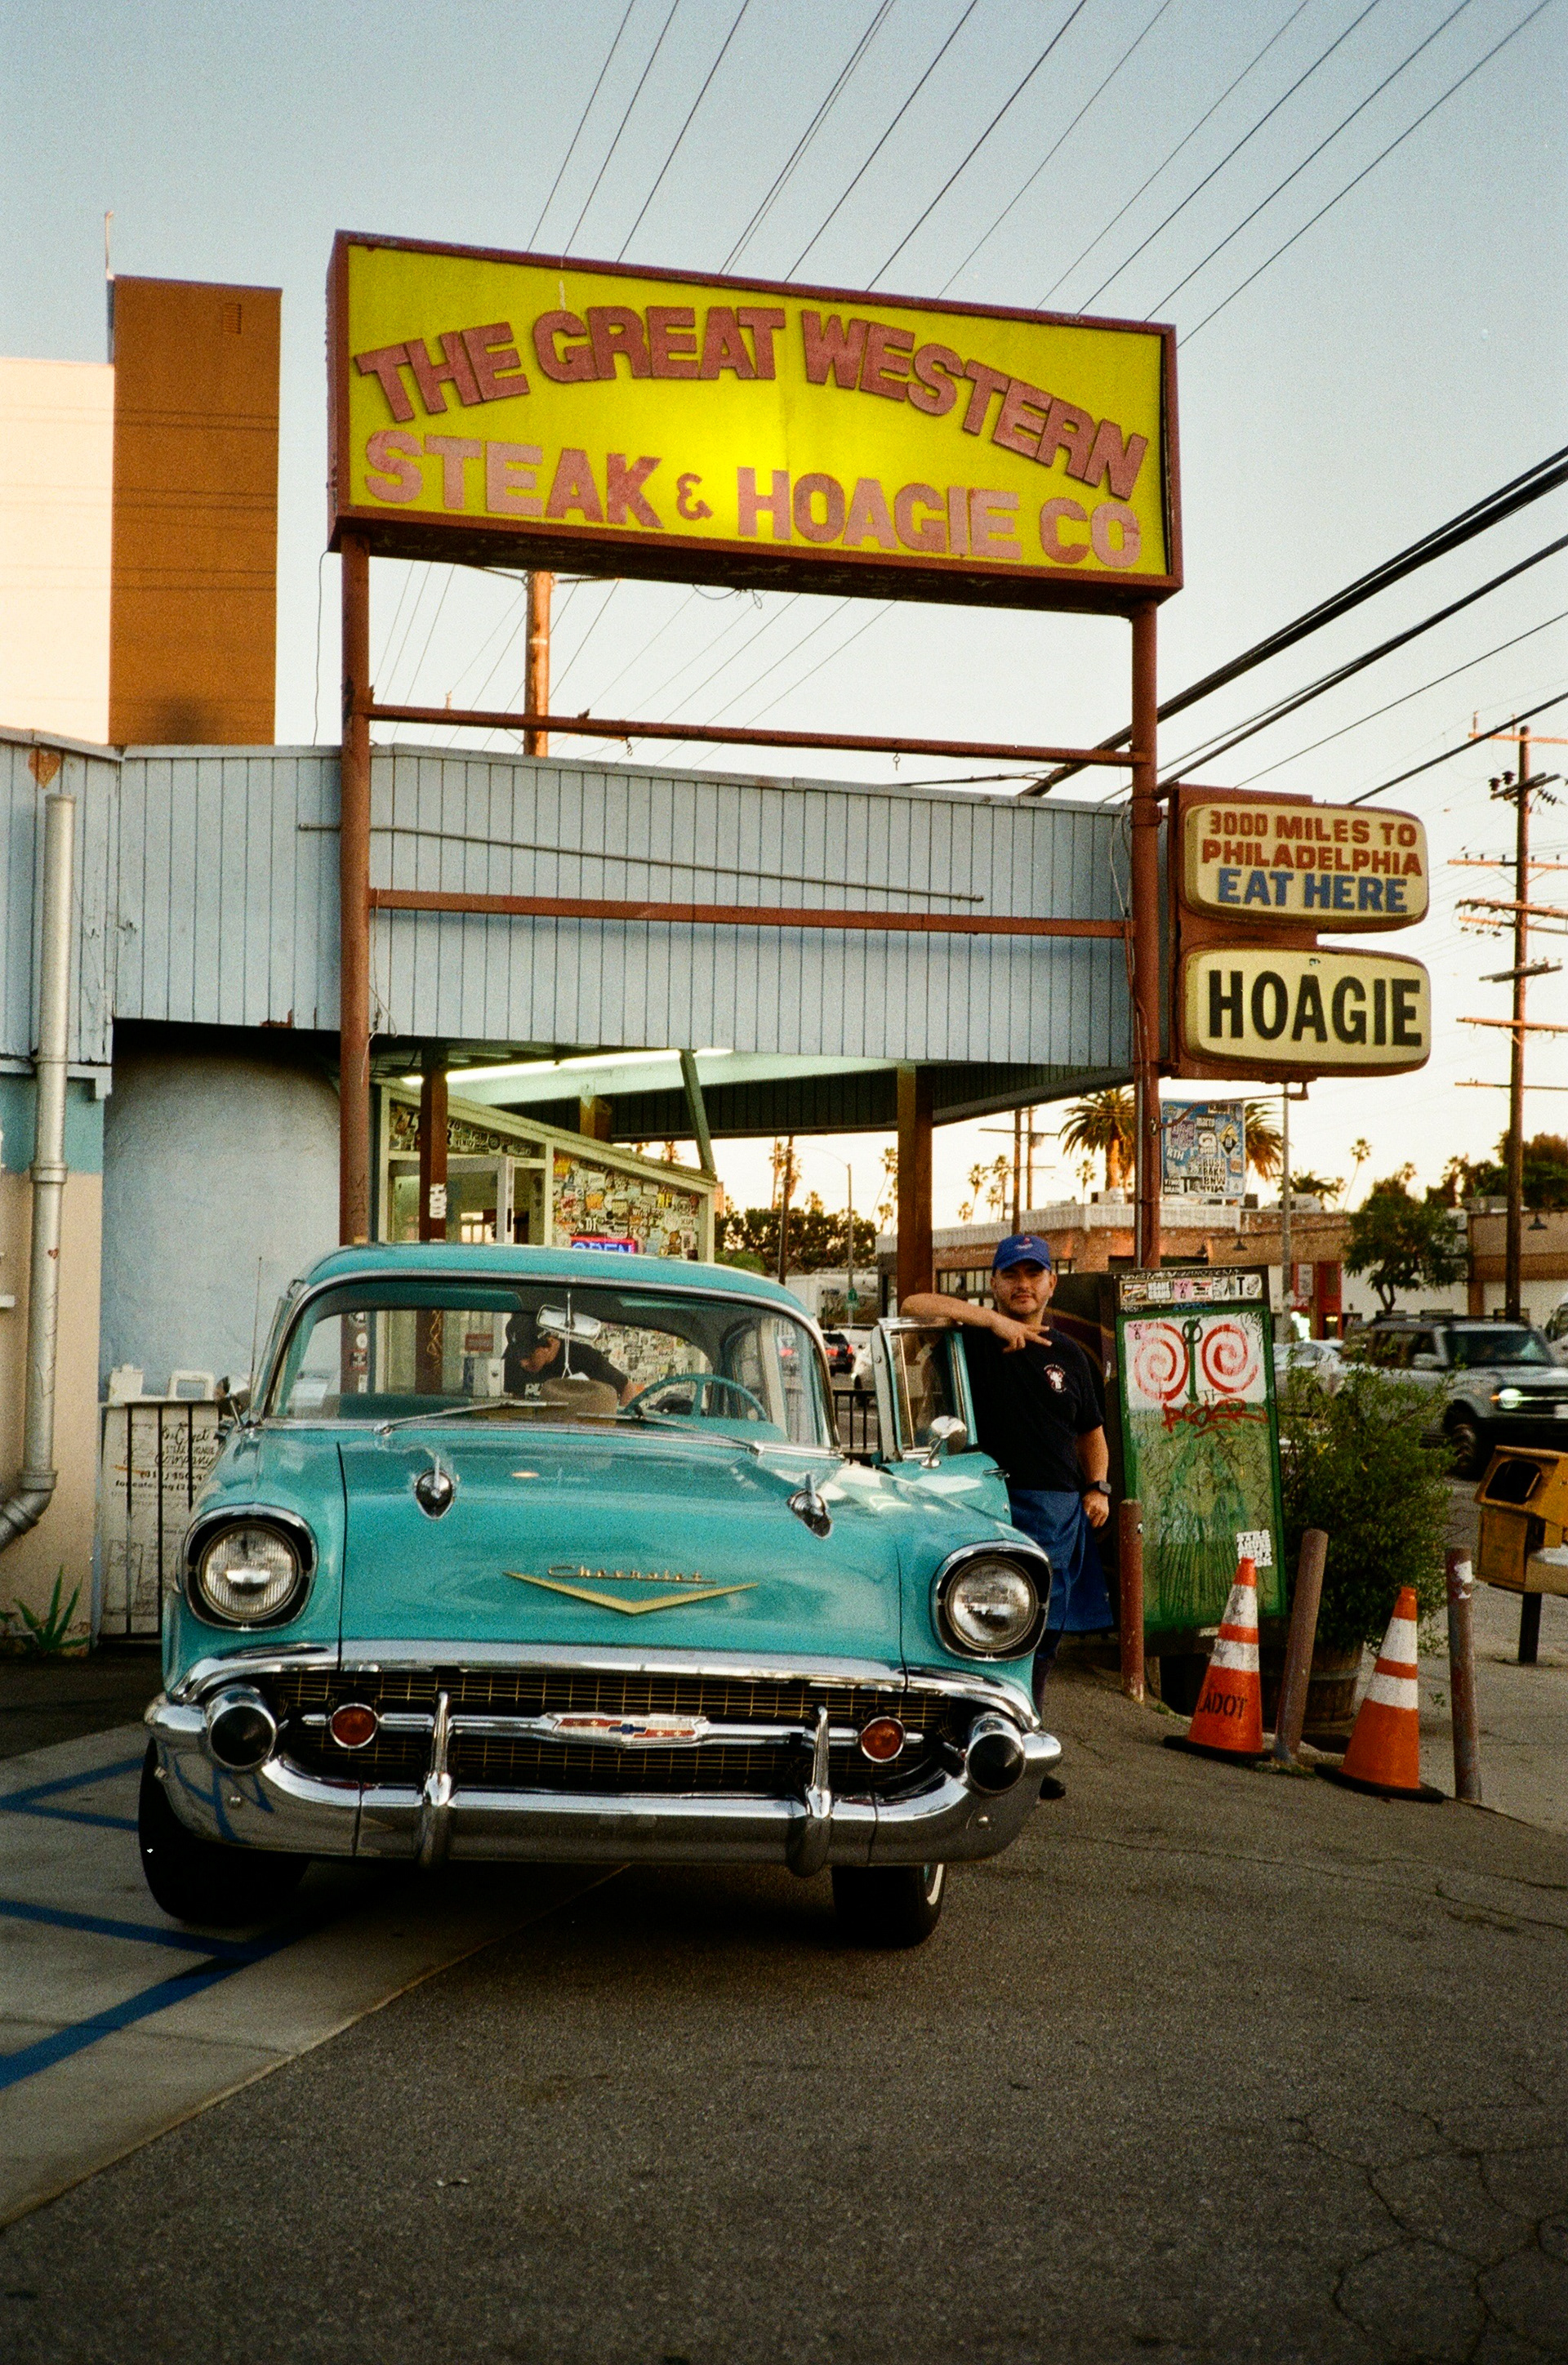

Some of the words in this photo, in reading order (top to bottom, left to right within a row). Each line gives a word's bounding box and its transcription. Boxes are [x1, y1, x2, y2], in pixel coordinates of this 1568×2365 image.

[354, 322, 530, 422] THE
[532, 305, 786, 382] GREAT
[801, 309, 1147, 501] WESTERN
[364, 430, 664, 528] STEAK
[676, 472, 713, 520] &
[737, 466, 1022, 559] HOAGIE
[1040, 497, 1141, 568] CO
[1201, 839, 1423, 876] PHILADELPHIA
[1209, 809, 1268, 837] 3000
[1276, 815, 1370, 844] MILES
[1380, 822, 1417, 847] TO
[1218, 867, 1294, 906] EAT
[1304, 872, 1408, 913] HERE
[1209, 969, 1423, 1047] HOAGIE
